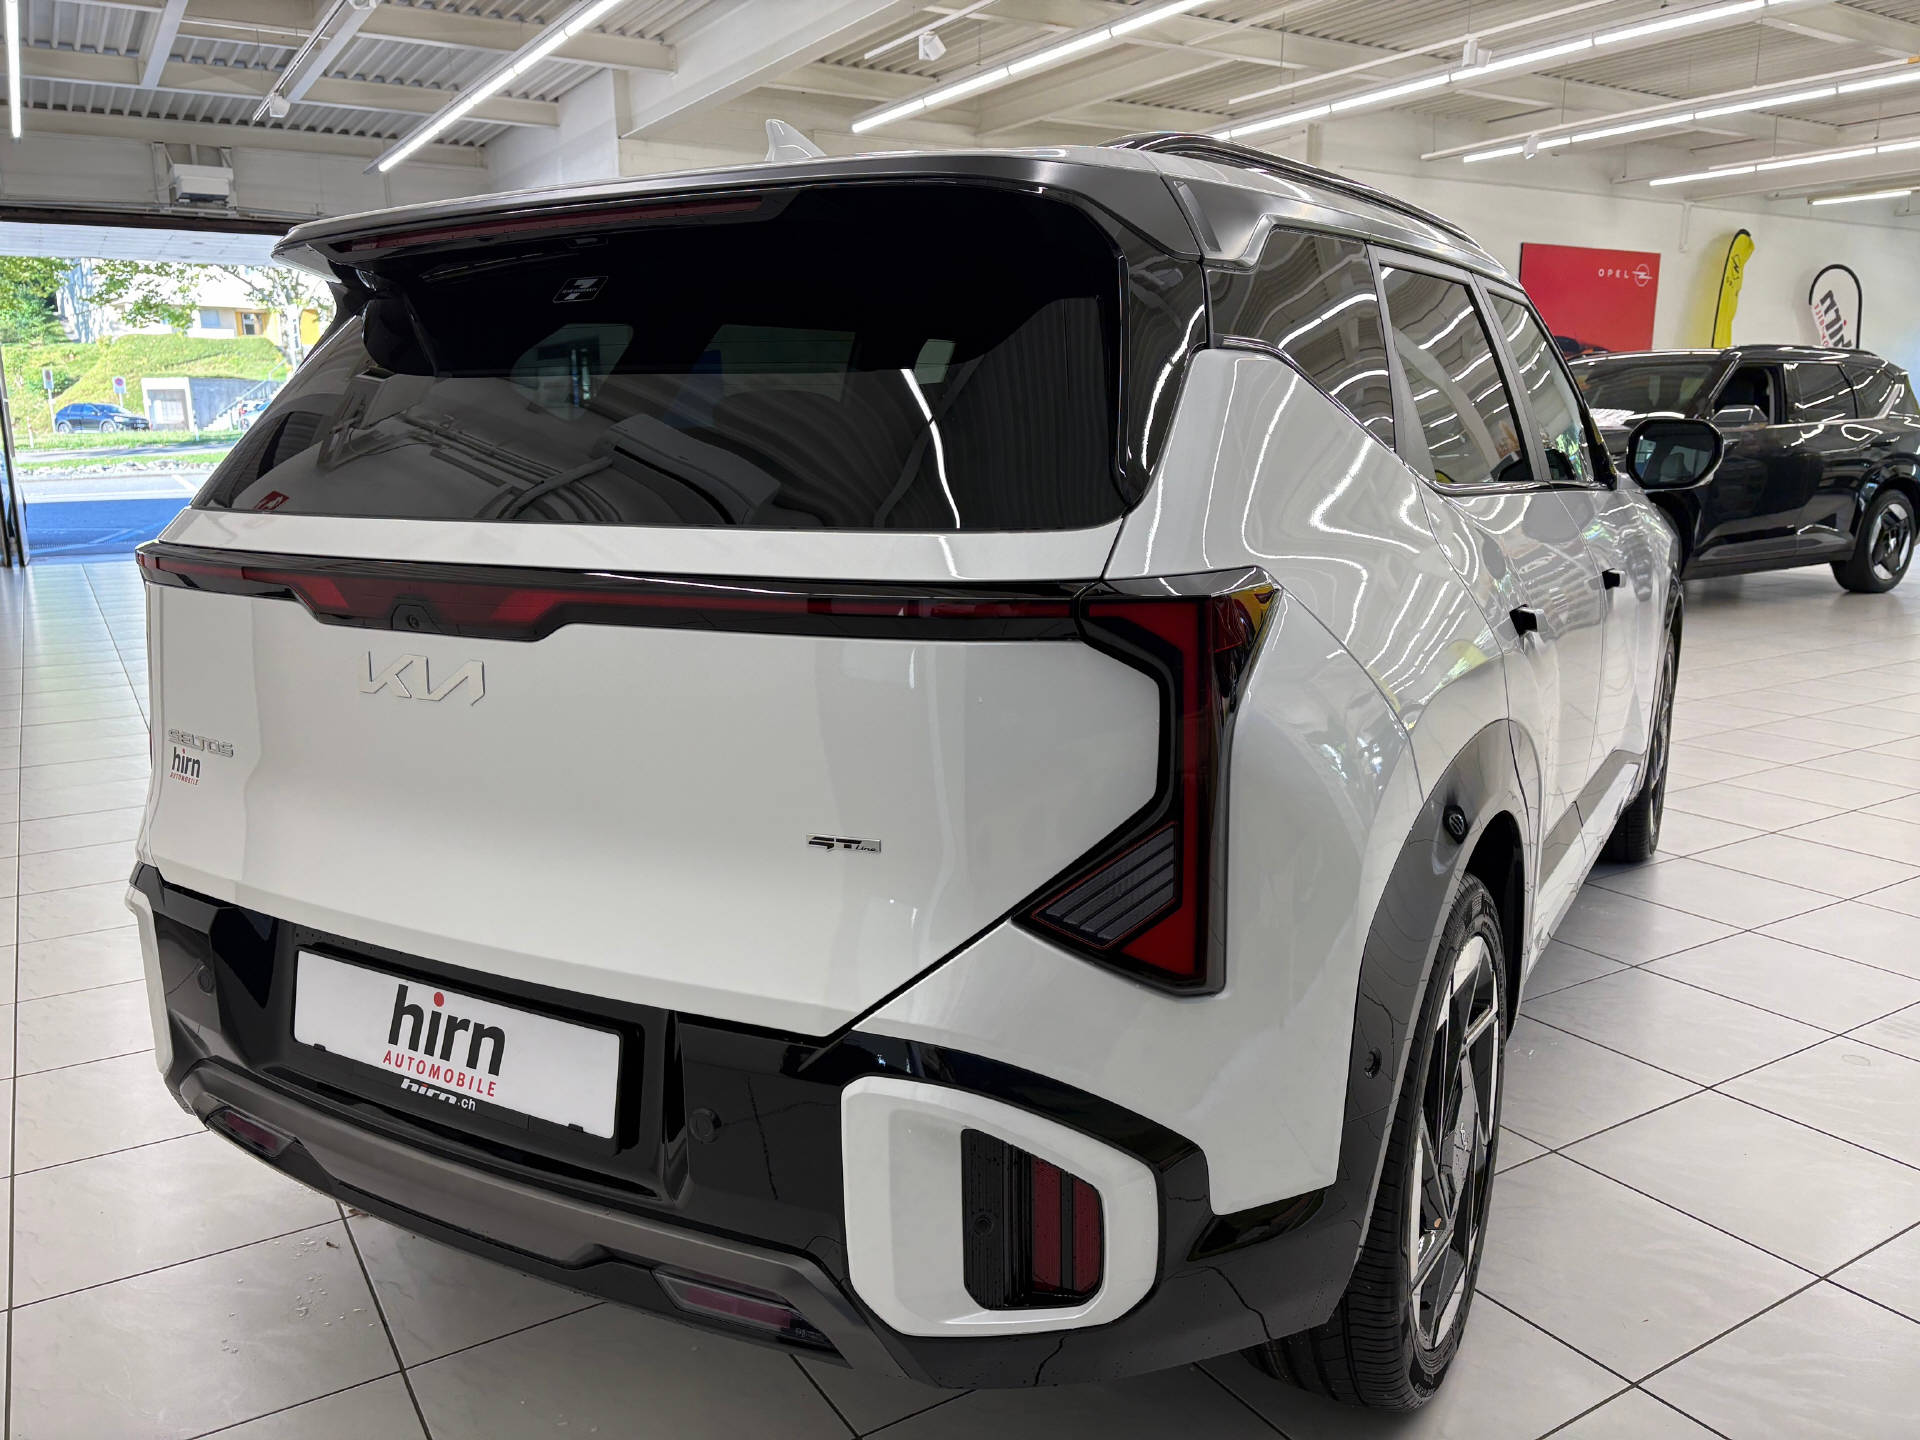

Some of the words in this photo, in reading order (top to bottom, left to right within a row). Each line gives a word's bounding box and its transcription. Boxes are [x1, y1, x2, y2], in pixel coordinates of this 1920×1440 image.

[1598, 268, 1630, 279] OPEL
[359, 651, 486, 706] KIA
[168, 728, 234, 758] SELTOS
[171, 746, 201, 778] hirn
[169, 771, 200, 786] AUTOMOBILE
[387, 983, 506, 1076] hirn
[382, 1049, 497, 1098] AUTOMOBILE
[400, 1078, 476, 1111] hirn.ch
